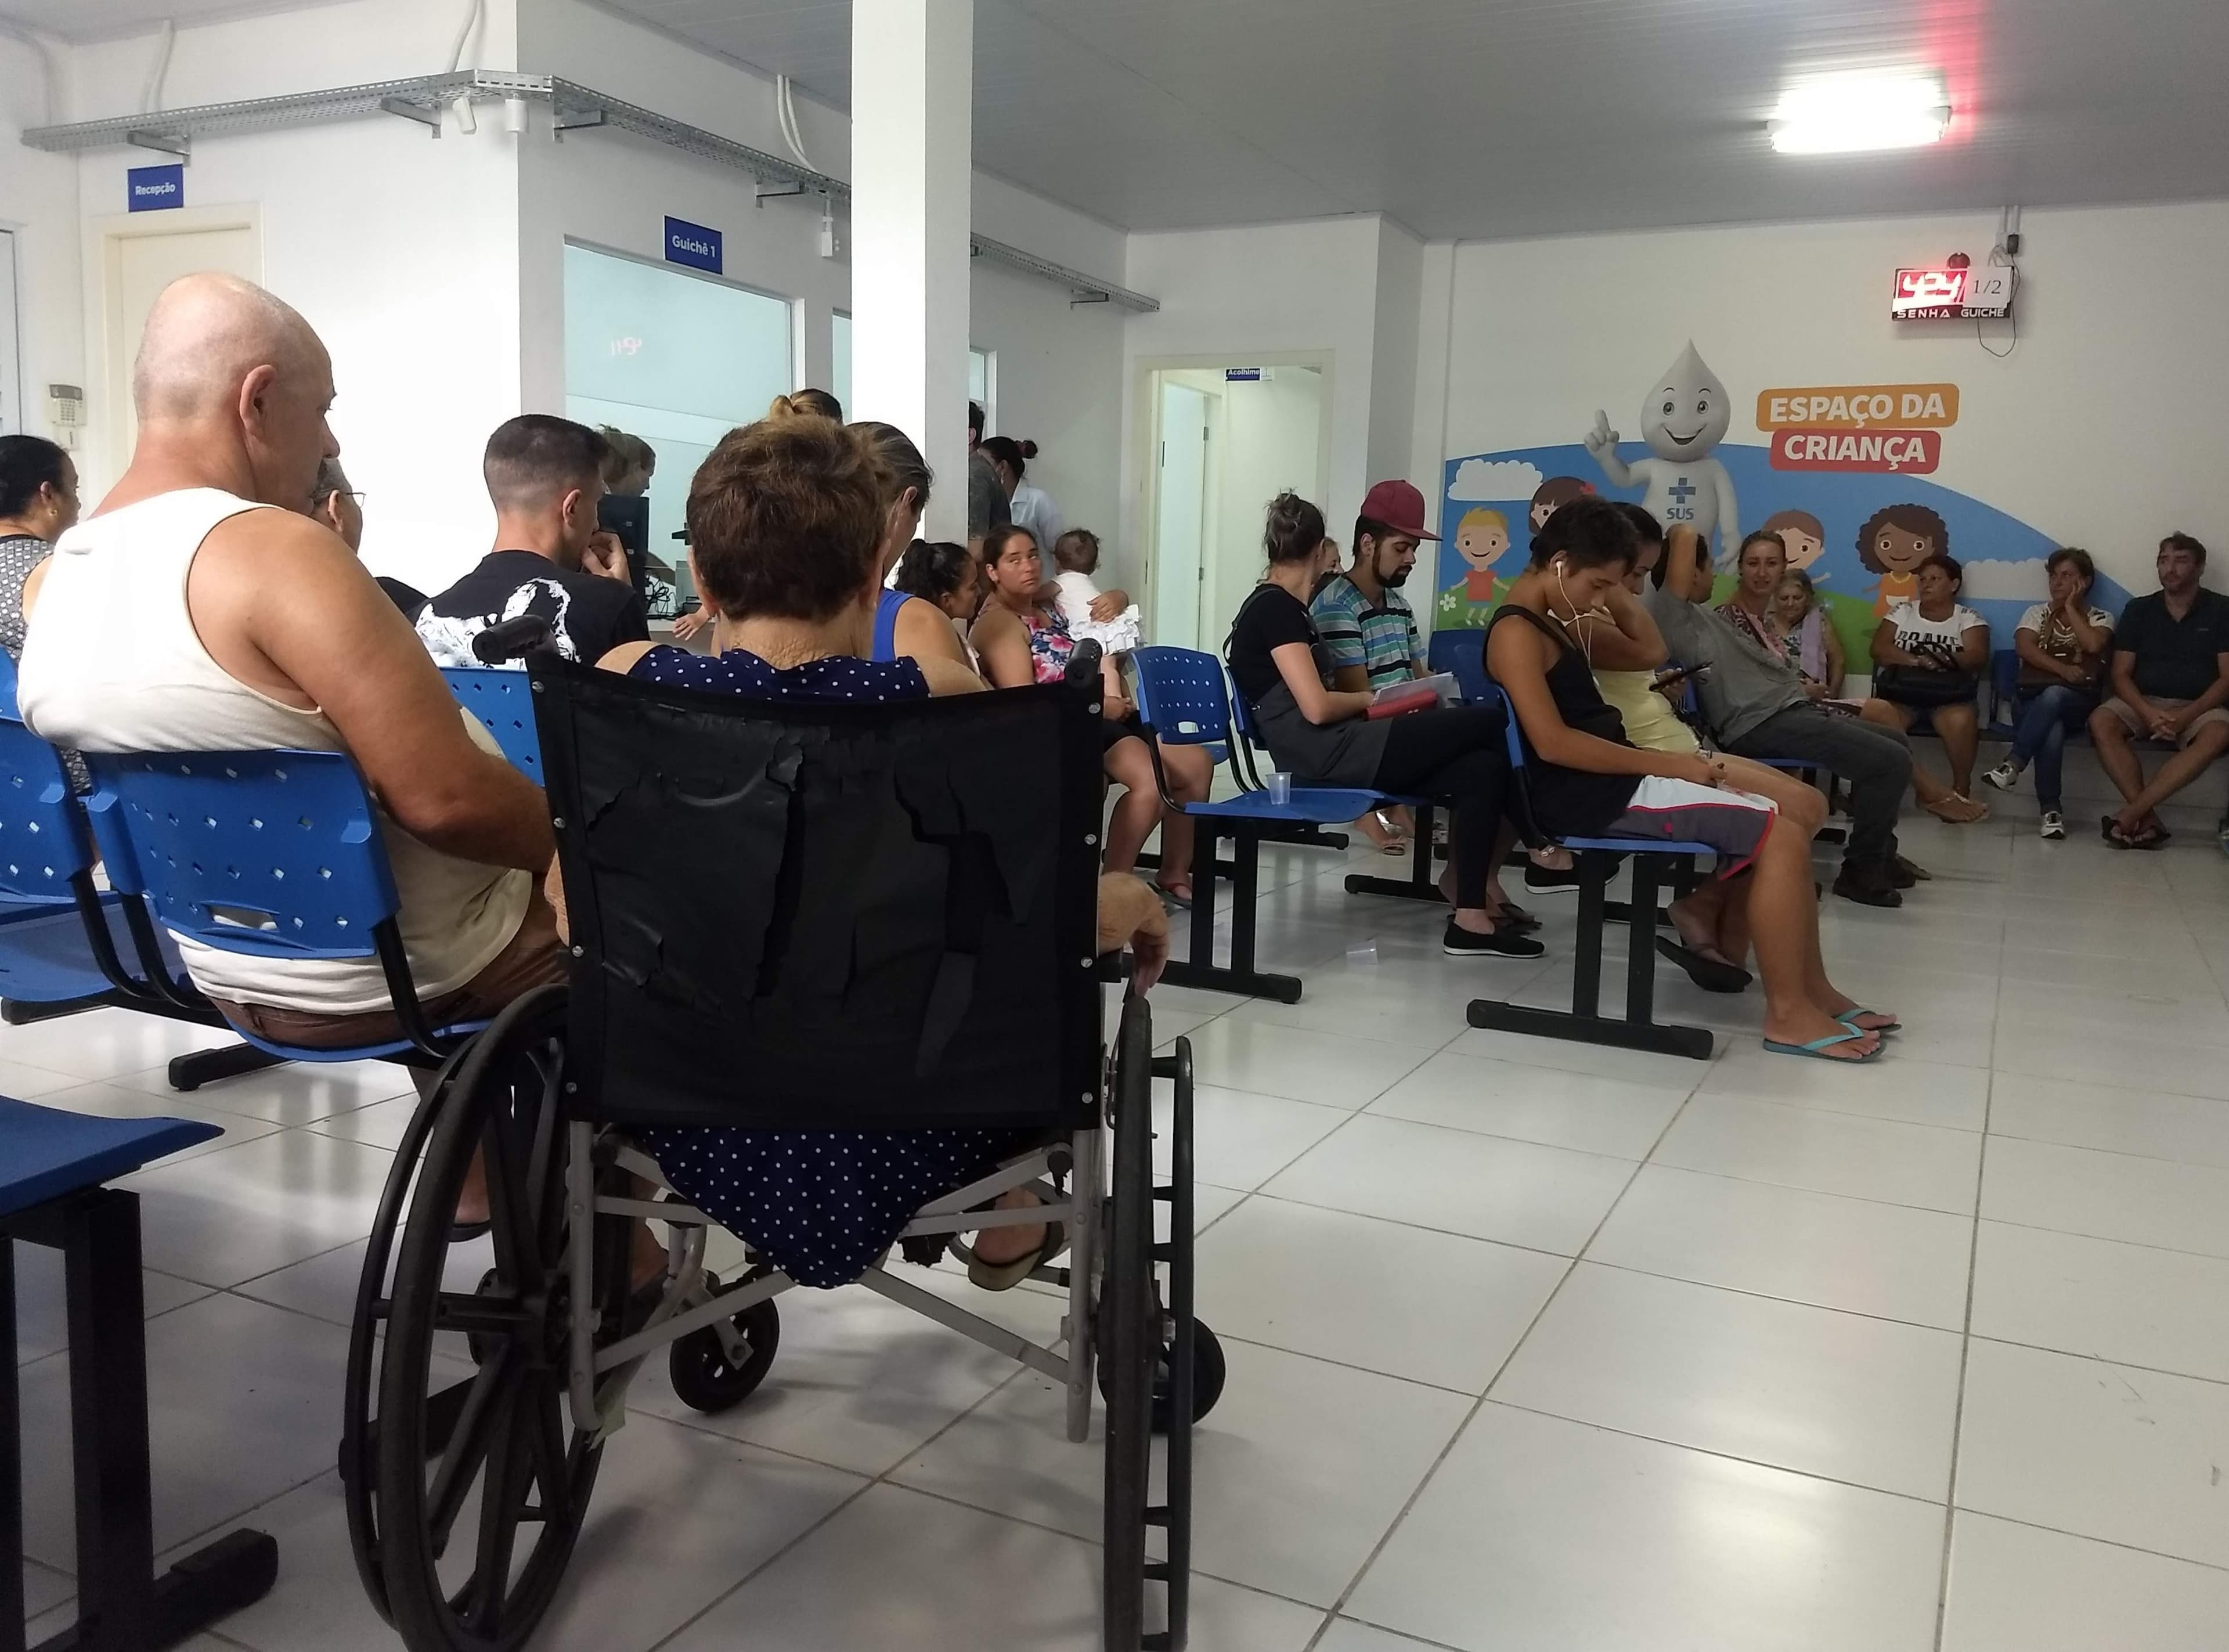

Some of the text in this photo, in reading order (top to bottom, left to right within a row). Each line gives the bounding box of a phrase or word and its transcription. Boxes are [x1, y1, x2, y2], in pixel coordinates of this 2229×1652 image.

[135, 182, 176, 196] Recepção
[672, 235, 715, 258] Guichê 1
[1974, 280, 2001, 294] 1/2
[1897, 308, 2004, 318] SENHA GUICHE
[1770, 393, 1945, 428] ESPAÇO DA
[1784, 435, 1926, 471] CRIANÇA
[1667, 508, 1694, 520] SUS
